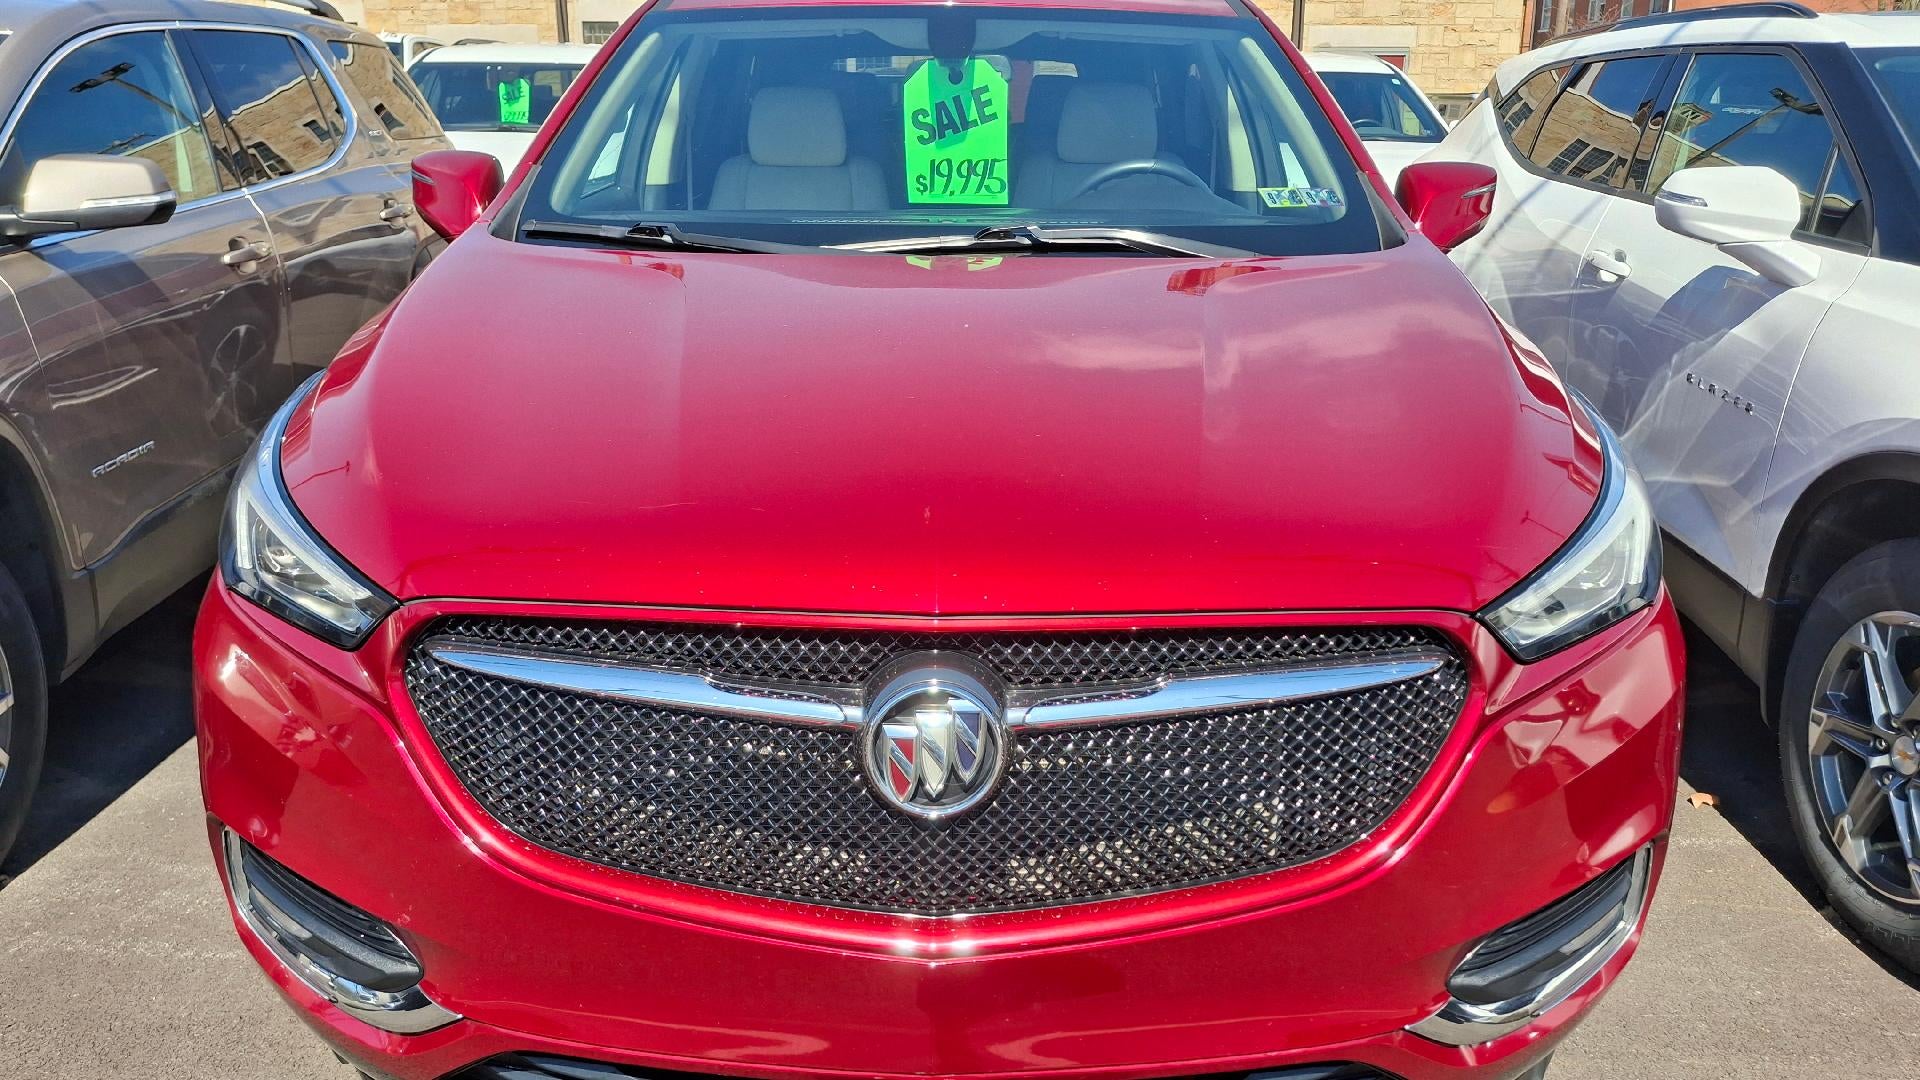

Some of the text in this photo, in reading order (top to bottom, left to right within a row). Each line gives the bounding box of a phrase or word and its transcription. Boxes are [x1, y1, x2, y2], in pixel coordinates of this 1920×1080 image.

[911, 85, 998, 145] SALE
[915, 158, 1007, 196] $19,995
[1686, 372, 1754, 416] BLAZER
[92, 440, 155, 478] ACADIA
